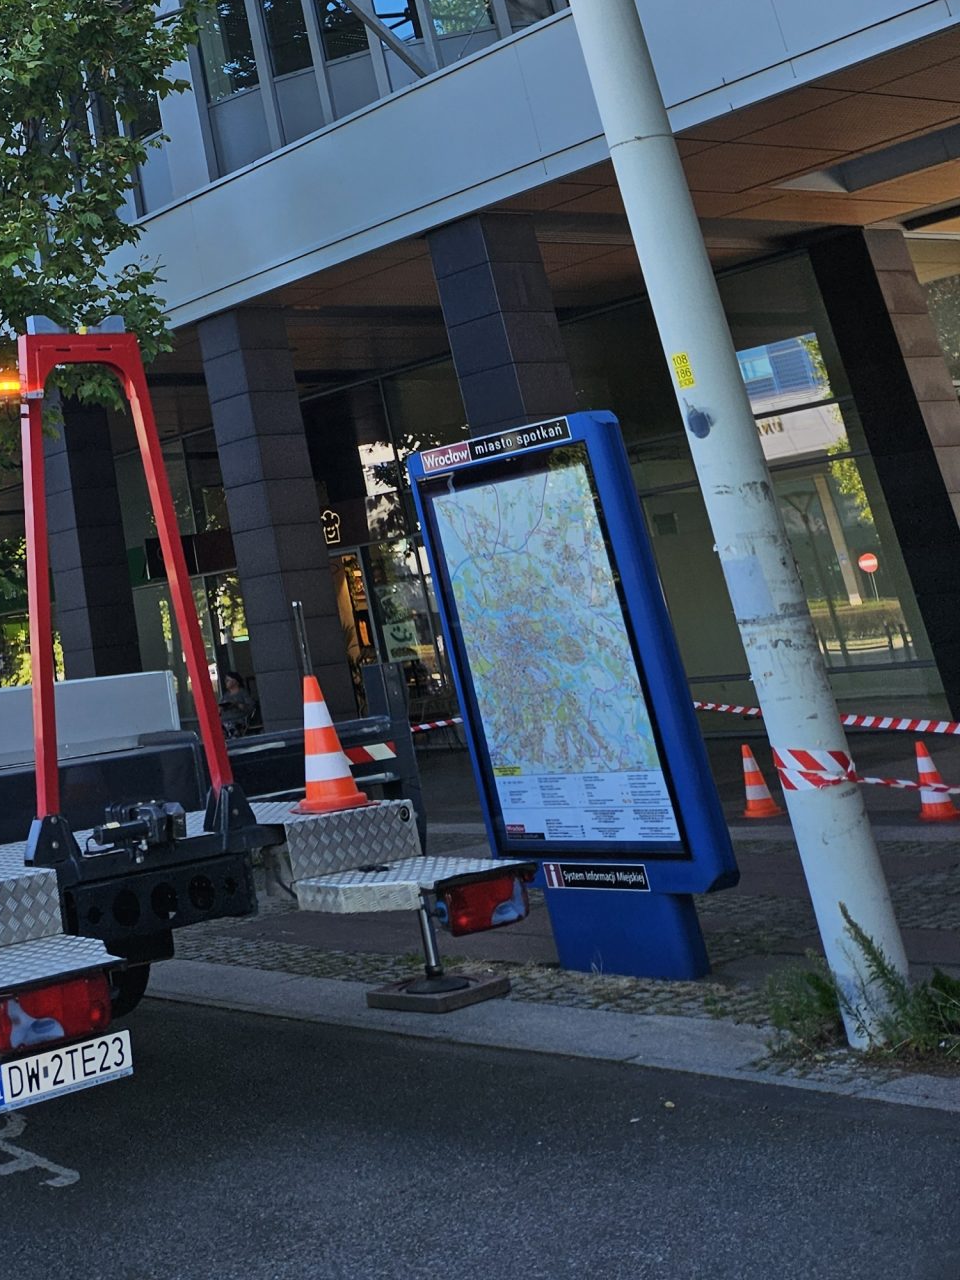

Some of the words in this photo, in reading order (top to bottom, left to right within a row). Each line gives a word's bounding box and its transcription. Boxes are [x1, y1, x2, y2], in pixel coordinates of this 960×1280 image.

[423, 448, 468, 468] Wrocław
[475, 438, 513, 455] miasto
[517, 422, 563, 446] spotkań
[563, 870, 585, 883] System
[585, 870, 616, 884] Informacji
[616, 871, 645, 885] Miejskiej
[8, 1059, 40, 1098] DW
[51, 1037, 125, 1086] 2TE23
